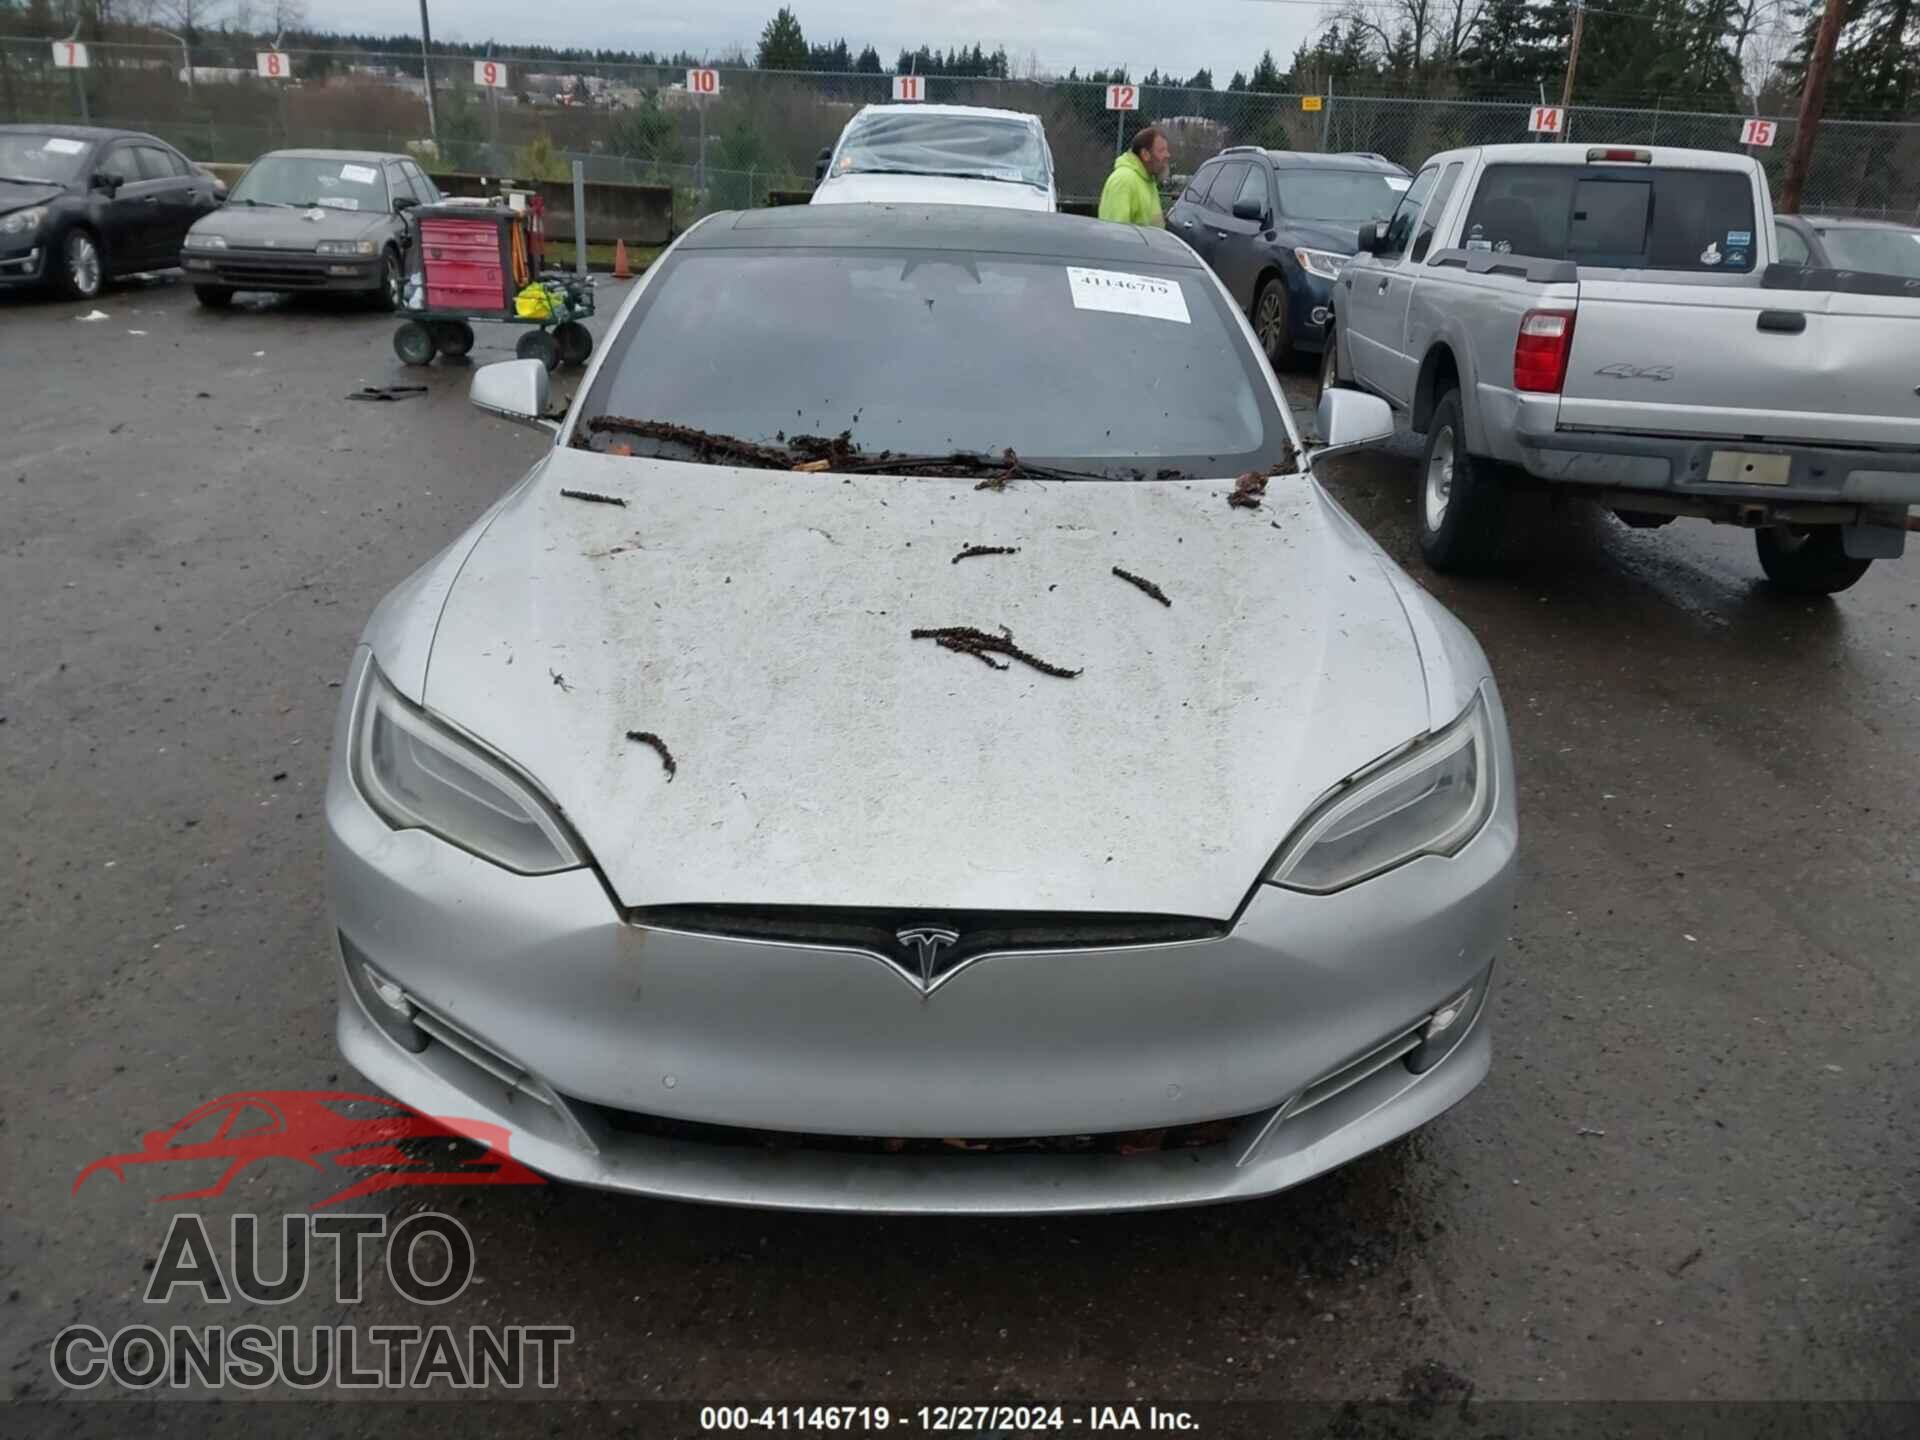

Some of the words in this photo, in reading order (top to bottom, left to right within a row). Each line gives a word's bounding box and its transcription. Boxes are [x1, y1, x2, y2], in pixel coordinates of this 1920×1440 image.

[64, 43, 76, 65] 7
[267, 54, 281, 77] 8
[484, 63, 497, 85] 9
[692, 70, 715, 92] 10
[901, 77, 917, 98] 11
[1111, 87, 1133, 108] 12
[1536, 108, 1558, 129] 14
[1747, 121, 1771, 144] 15
